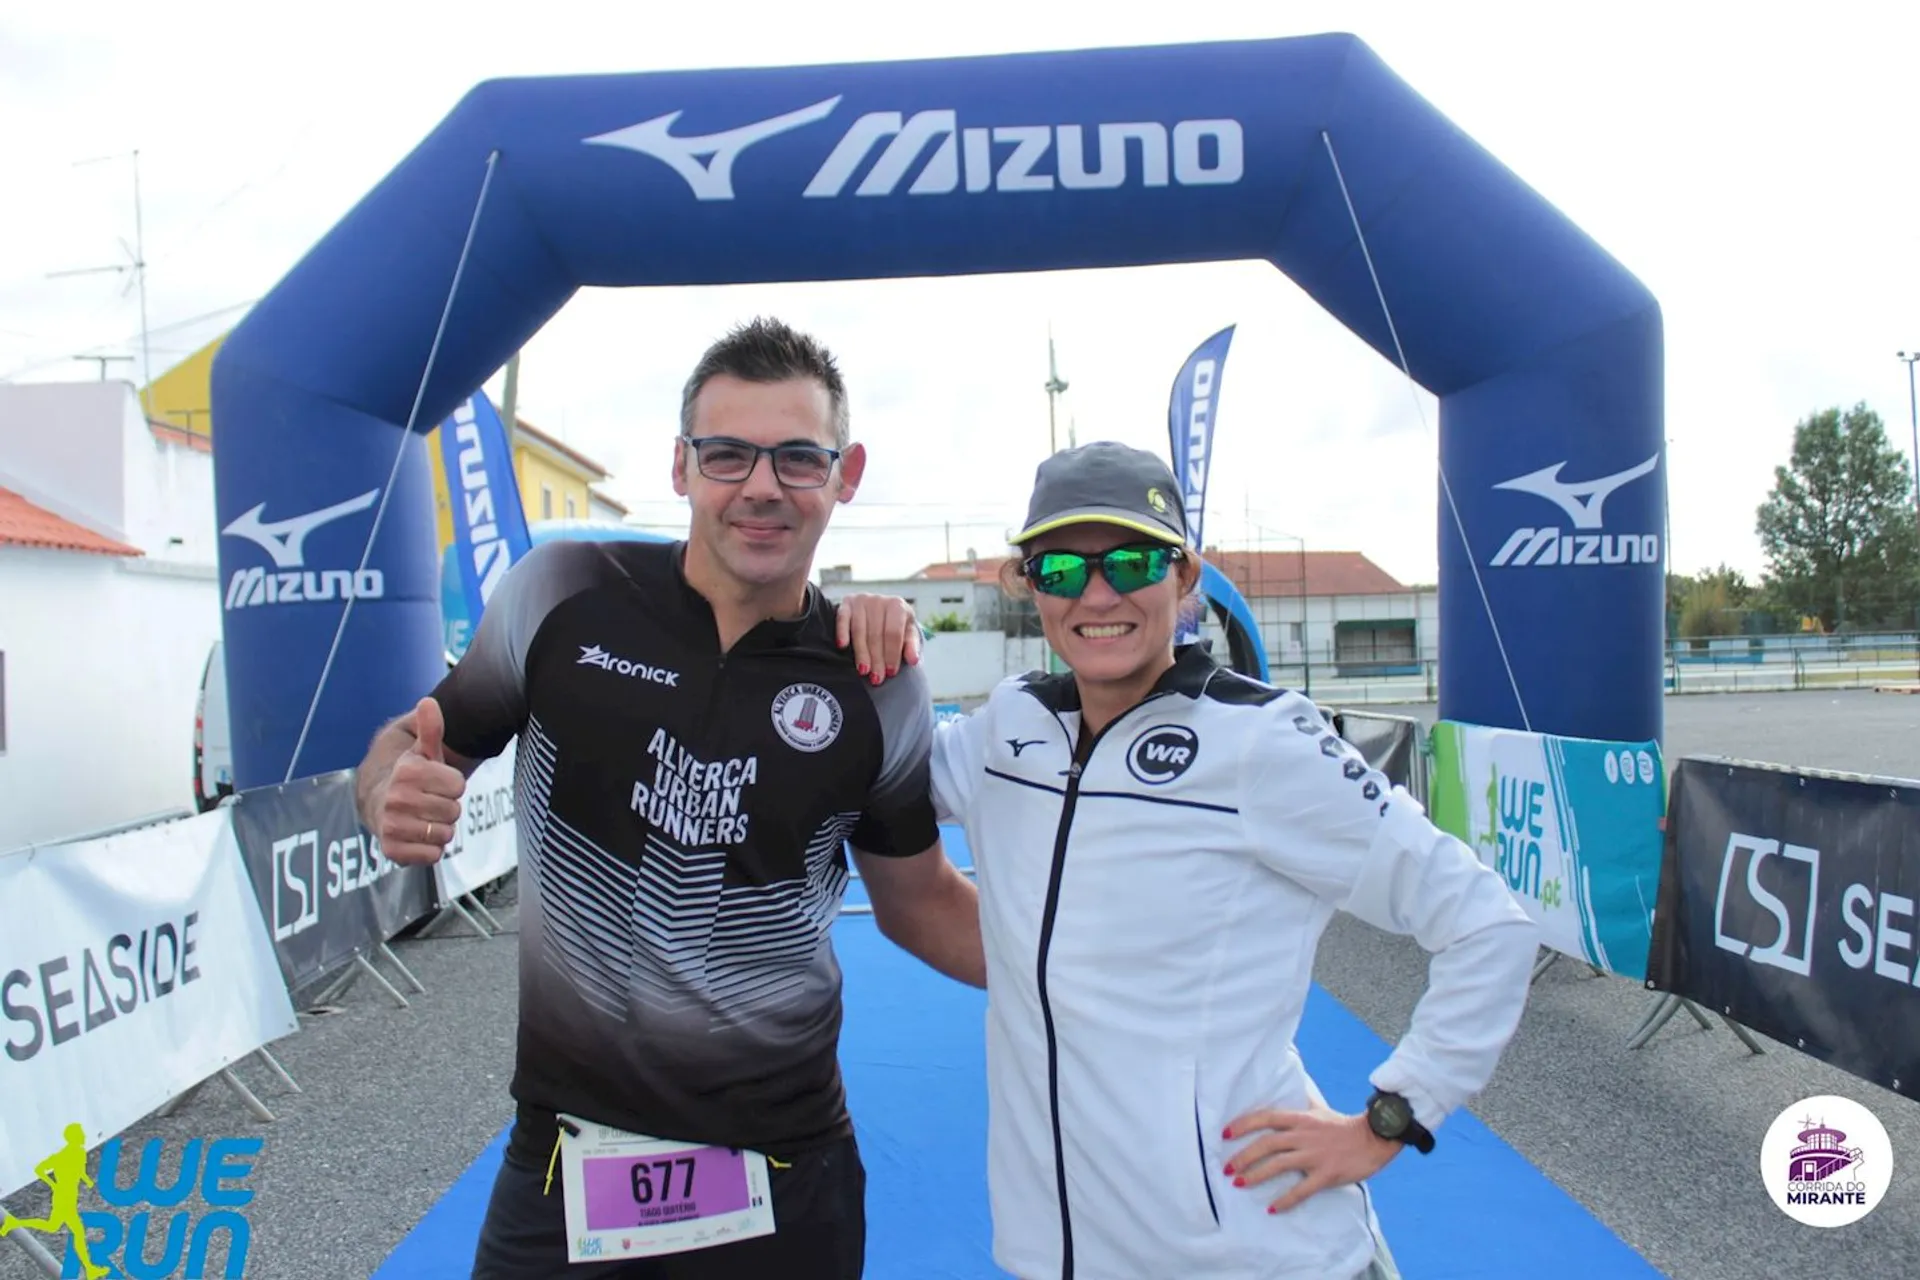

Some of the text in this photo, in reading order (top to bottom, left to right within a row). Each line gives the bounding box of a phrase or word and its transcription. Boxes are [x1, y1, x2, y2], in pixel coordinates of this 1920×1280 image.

[803, 109, 1244, 198] MIZUNO
[1489, 527, 1659, 566] MIZUNO
[225, 566, 384, 610] MIZUNO
[647, 728, 757, 792] ALVERCA
[1146, 742, 1191, 766] WR
[631, 781, 749, 847] RUNNERS
[654, 762, 741, 818] URBAN
[1502, 775, 1545, 838] WE
[1838, 883, 1920, 988] SE
[1, 911, 202, 1062] SEASIDE
[630, 1157, 696, 1205] 677
